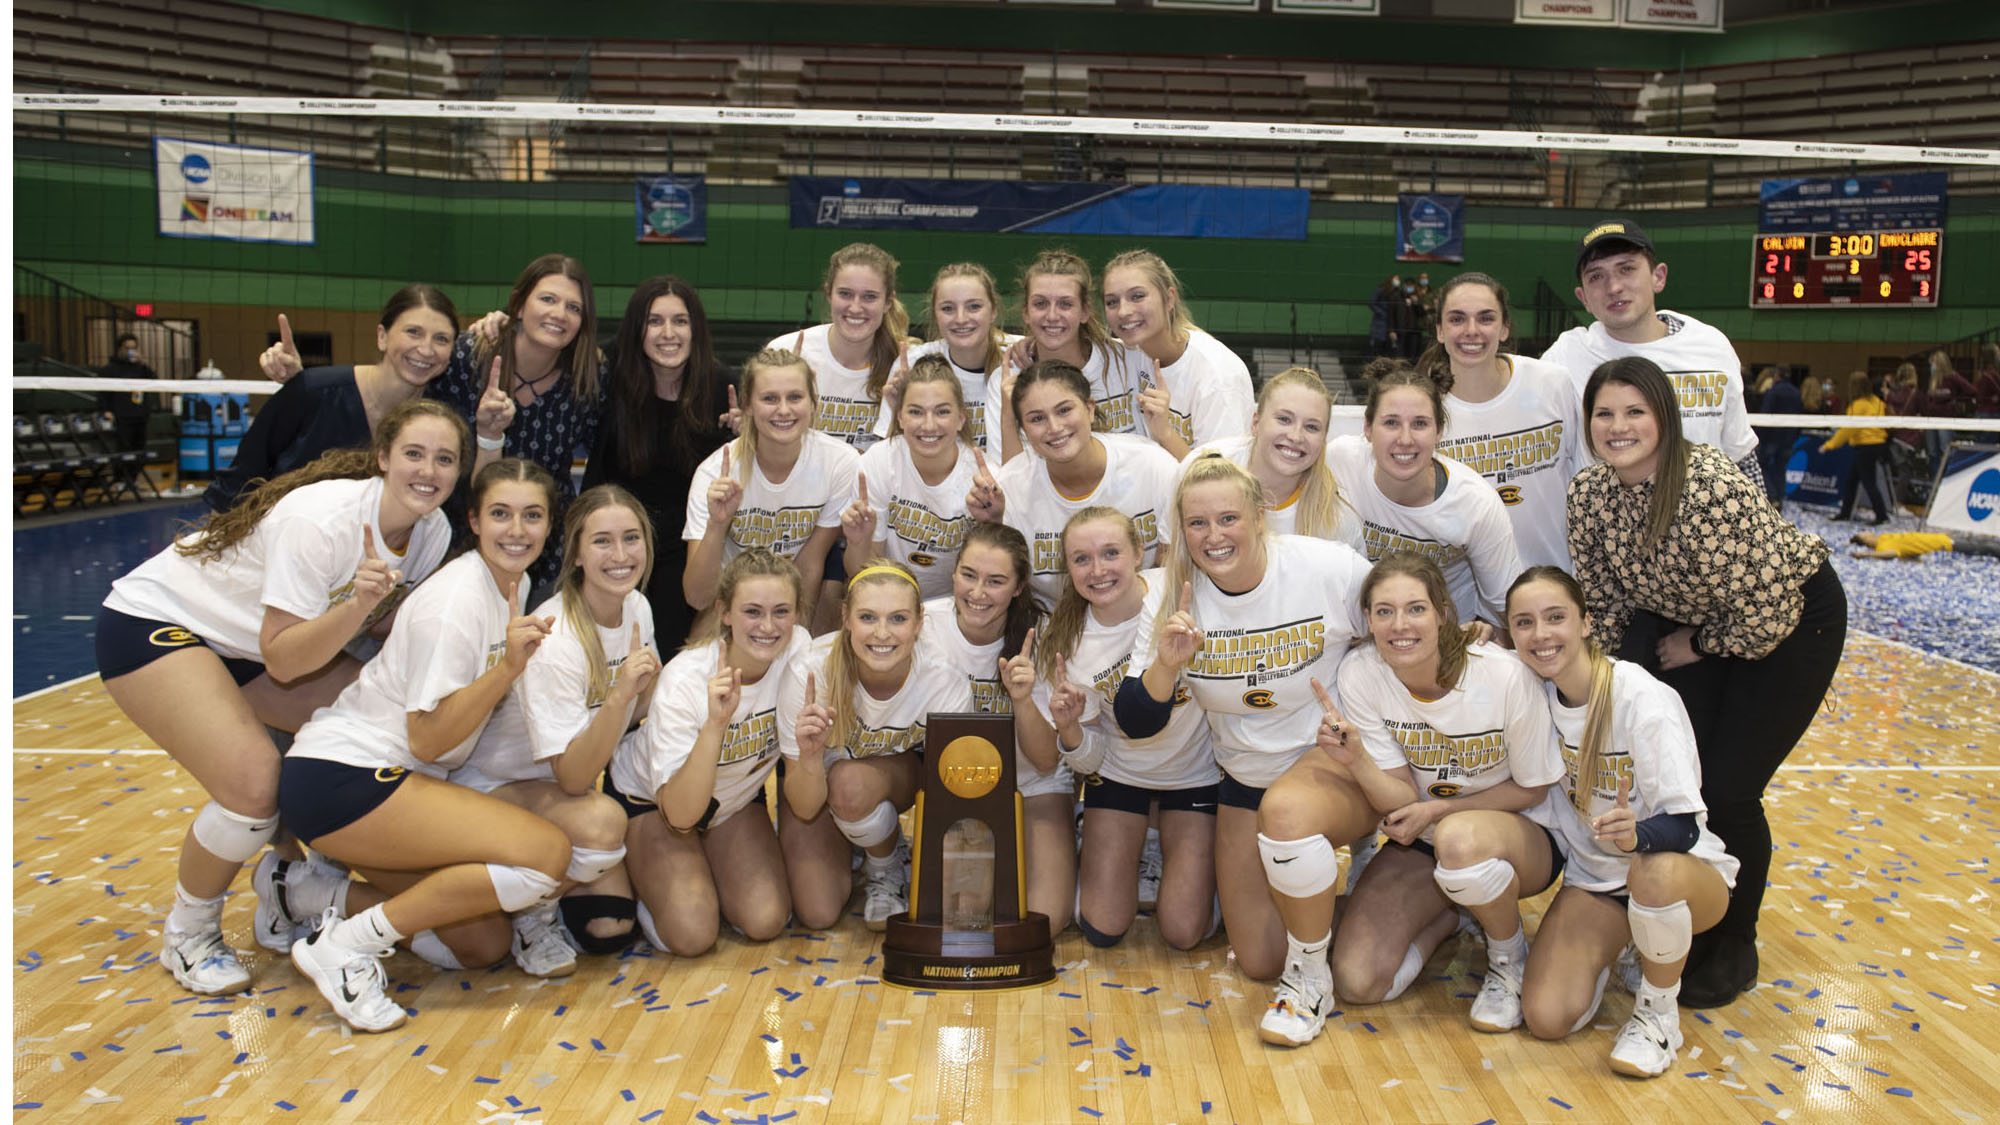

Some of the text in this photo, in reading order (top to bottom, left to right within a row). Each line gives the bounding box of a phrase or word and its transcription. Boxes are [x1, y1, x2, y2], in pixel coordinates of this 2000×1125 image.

[901, 204, 979, 218] CHAMPIONSHIP
[1762, 237, 1806, 251] CALVIN
[1829, 235, 1874, 256] 3:00
[1765, 253, 1791, 275] 21
[1849, 258, 1860, 275] 3
[1904, 249, 1932, 271] 25
[1793, 282, 1805, 299] 0
[1919, 280, 1930, 297] 3
[1455, 433, 1492, 446] NATIONAL
[1034, 532, 1053, 540] 2021
[1363, 519, 1400, 537] NATIONAL
[1206, 628, 1245, 639] NATIONAL
[1273, 640, 1307, 652] VOLLEYBALL
[1092, 651, 1132, 683] 2021 NATIO
[1401, 721, 1434, 730] NATION
[922, 963, 1021, 978] NATIONAL CHAMPION
